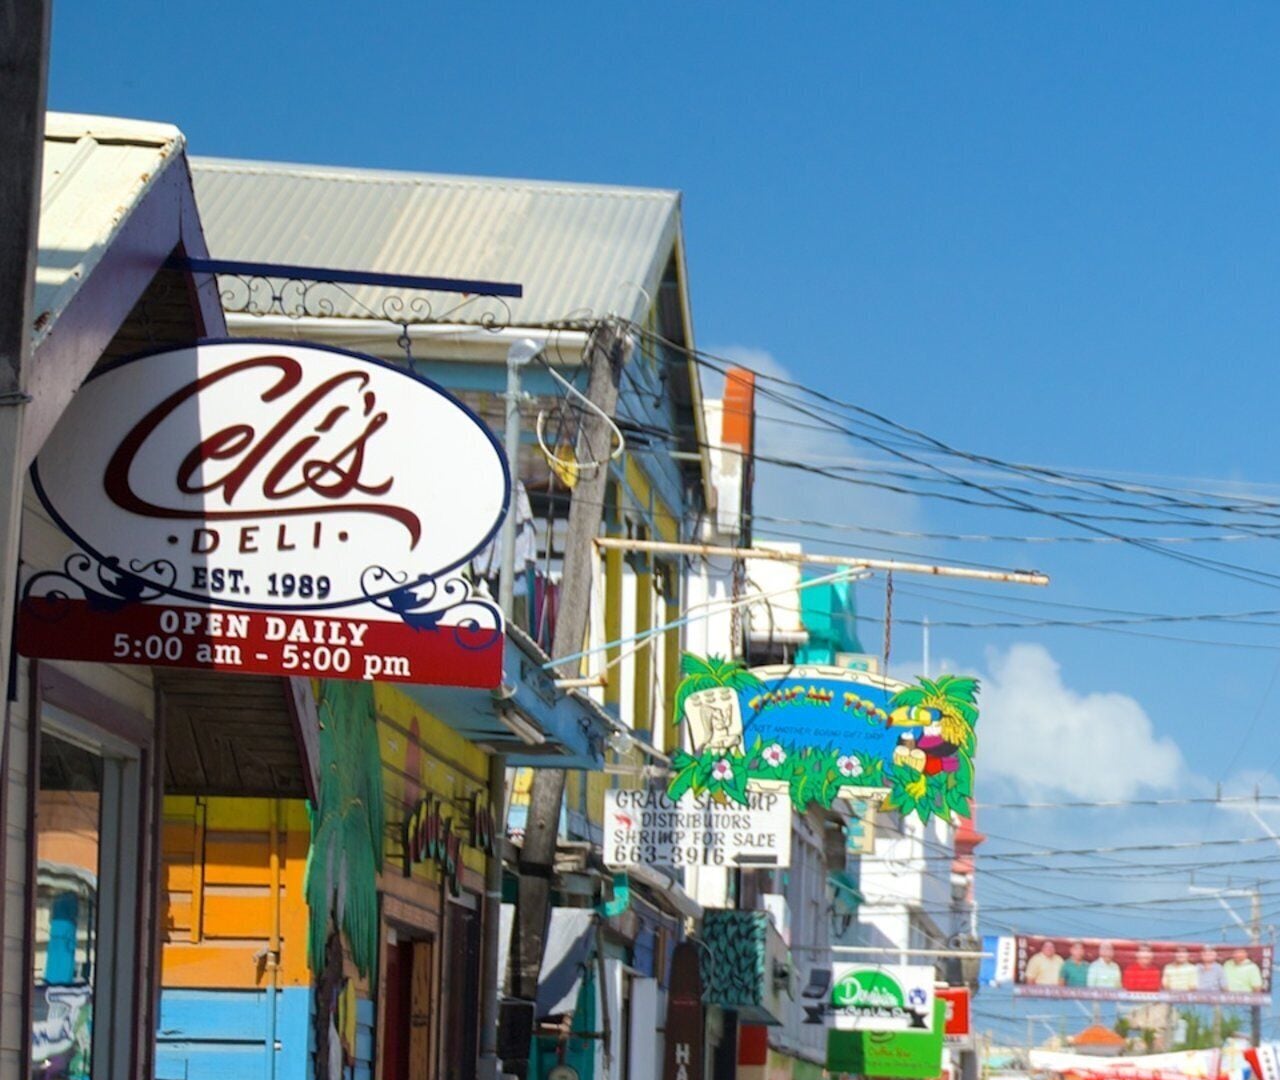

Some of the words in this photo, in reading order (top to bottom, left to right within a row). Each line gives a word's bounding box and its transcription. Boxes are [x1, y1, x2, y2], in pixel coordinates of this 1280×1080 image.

[104, 355, 420, 551] Celi's
[191, 521, 323, 555] DELI
[192, 567, 251, 595] EST.
[267, 572, 331, 599] 1989
[160, 610, 251, 638] OPEN
[265, 615, 369, 647] DAILY
[113, 633, 183, 662] 5:00
[198, 643, 242, 666] am
[282, 642, 351, 673] 5:00
[364, 652, 411, 679] pm
[748, 685, 835, 715] TOUCAN
[641, 812, 752, 829] DISTRIBUTORS
[614, 831, 686, 846] SHRIMP
[693, 833, 726, 846] FOR
[733, 833, 776, 848] SALE
[615, 846, 725, 865] 663-3916
